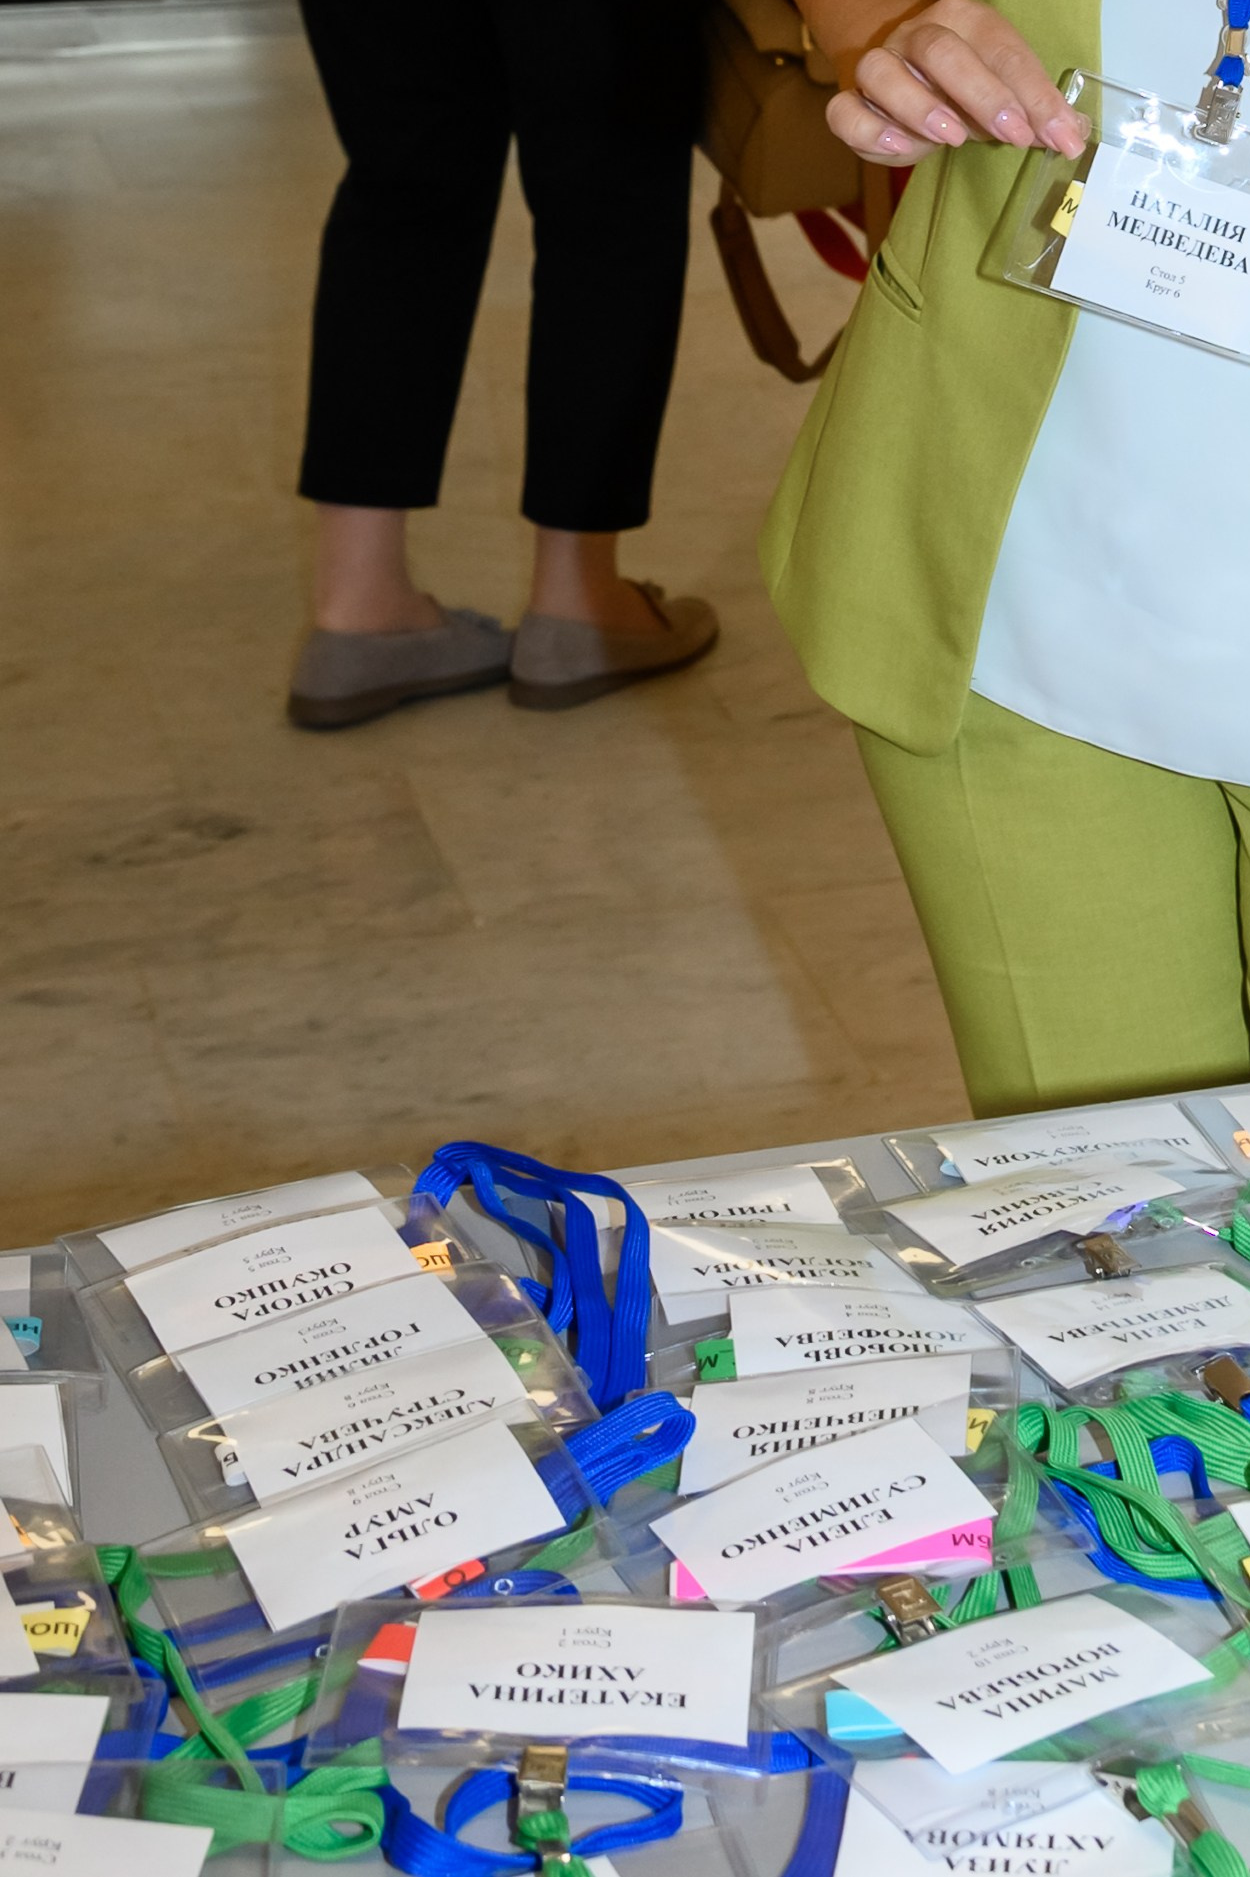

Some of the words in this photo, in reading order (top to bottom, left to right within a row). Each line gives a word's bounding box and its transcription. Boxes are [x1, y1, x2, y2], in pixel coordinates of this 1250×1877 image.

[1128, 188, 1248, 244] НАТАЛИЯ
[1105, 209, 1250, 276] МЕДВЕДЕВА
[1145, 278, 1172, 297] Круг
[1149, 264, 1177, 282] Стол
[1178, 273, 1187, 284] 5
[967, 1181, 1103, 1221] САВКИНА
[976, 1185, 1126, 1237] ВИКТОРИЯ
[251, 1245, 287, 1260] Круг
[257, 1254, 293, 1269] Стол
[690, 1256, 876, 1277] БОГДАНОВА
[212, 1260, 352, 1309] ОКУШКО
[720, 1266, 862, 1287] ЮЛИАНА
[231, 1279, 355, 1322] СИТОРА
[1044, 1294, 1233, 1344] ДЕМЕНТЬЕВА
[773, 1328, 966, 1348] ДОРОФЕЕВА
[1109, 1317, 1207, 1344] ЕЛЕНА
[252, 1322, 422, 1386] ГОРЛЕНКО
[293, 1345, 403, 1391] ЛИЛИЯ
[802, 1343, 943, 1363] ЛЮБОВЬ
[281, 1396, 497, 1479] АЛЕКСАНДРА
[297, 1388, 466, 1452] СТРУЧЕВА
[732, 1404, 920, 1439] ШЕВЧЕНКО
[358, 1472, 396, 1491] Круг
[363, 1481, 402, 1501] Стол
[342, 1491, 436, 1541] АМУР
[342, 1509, 459, 1560] ОЛЬГА
[719, 1472, 927, 1561] СУЛИМЕНКО
[783, 1508, 895, 1554] ЕЛЕНА
[571, 1638, 612, 1649] Стол
[573, 1625, 612, 1638] Круг
[515, 1661, 646, 1682] АХИКО
[934, 1640, 1122, 1710] ВОРОБЬЕВА
[467, 1682, 688, 1710] ЕКАТЕРИНА
[980, 1665, 1121, 1720] МАРИНА
[900, 1828, 1115, 1851] АХТЯМОВА
